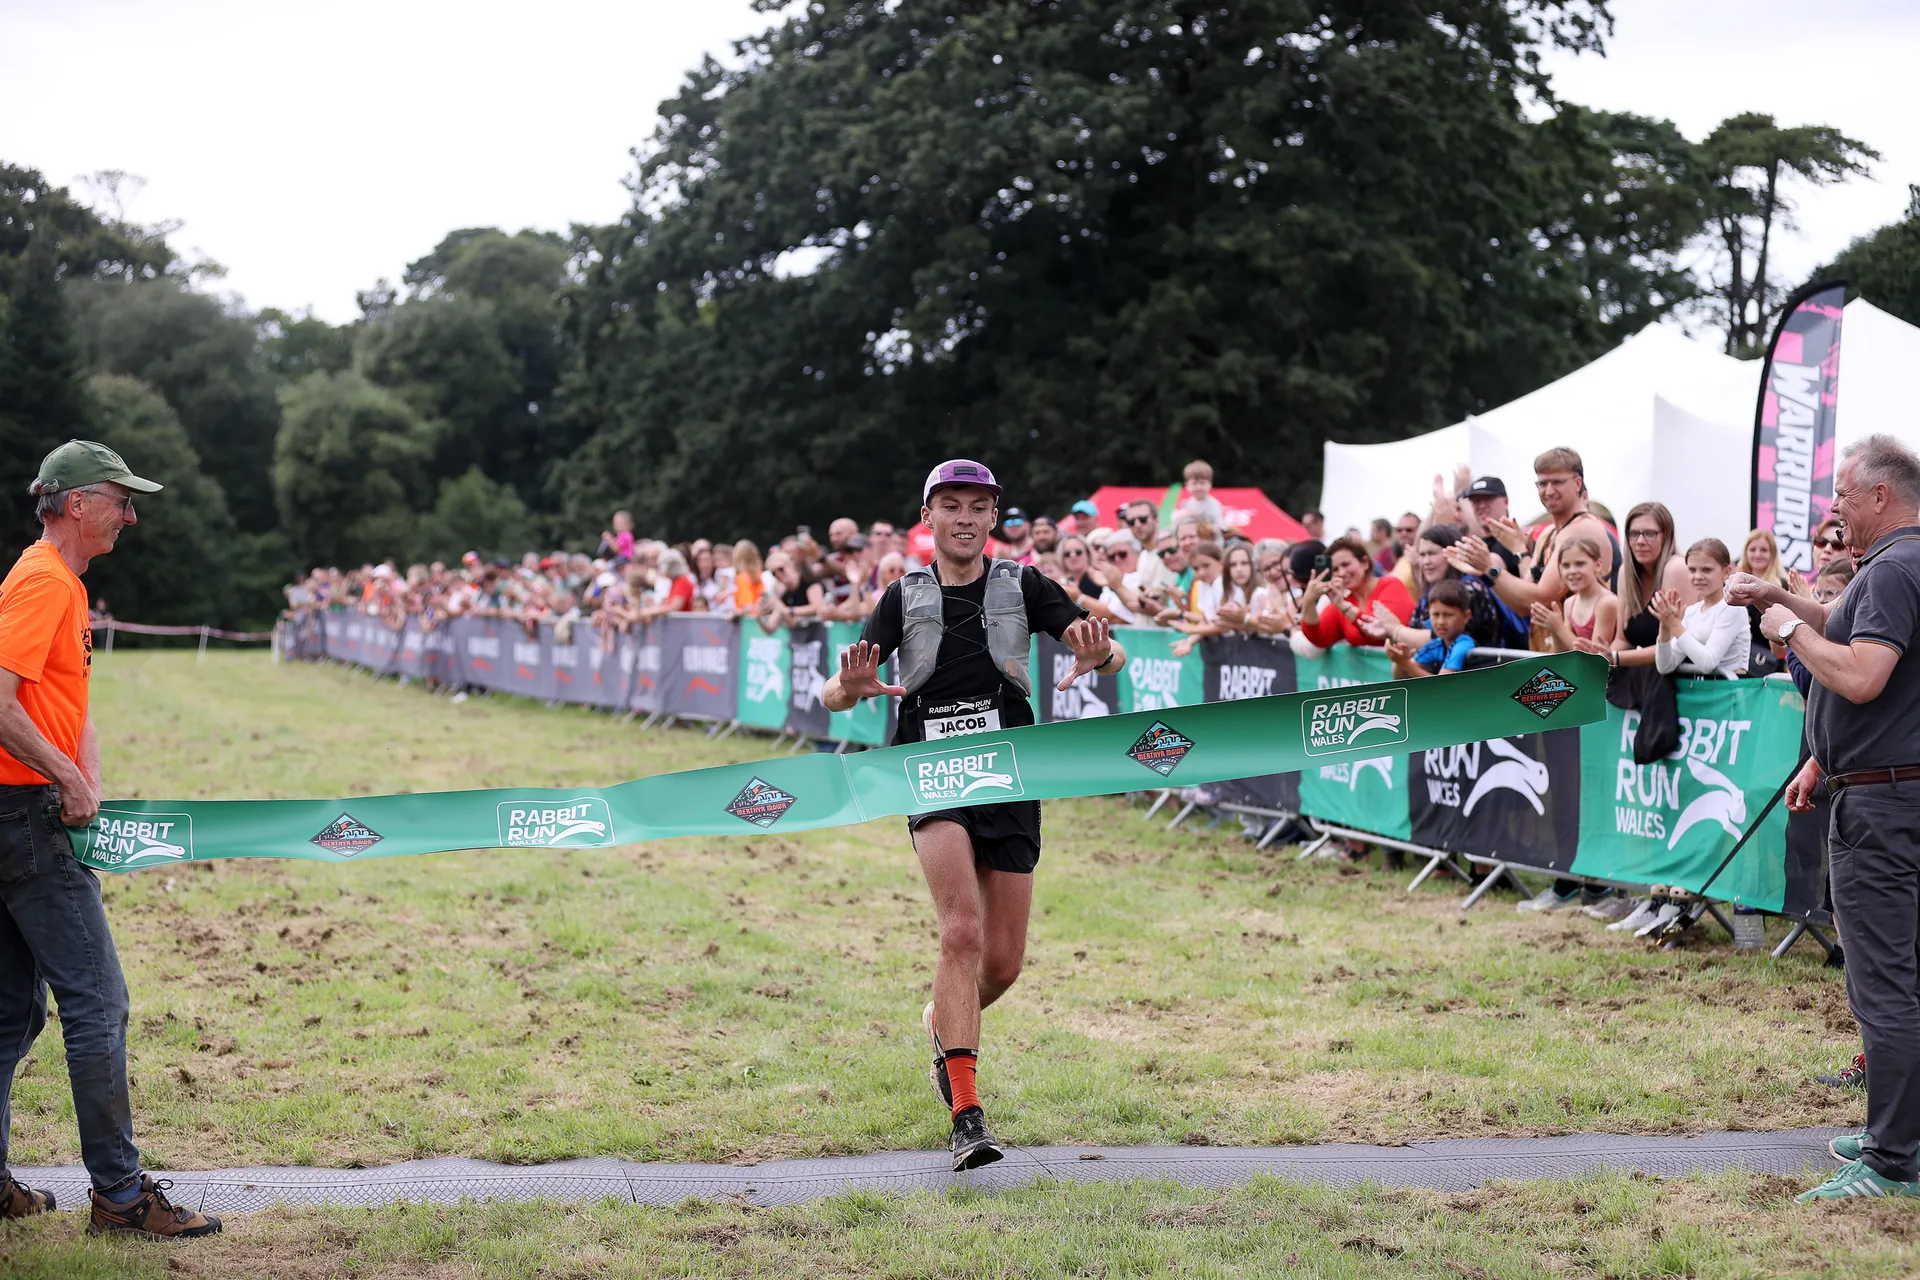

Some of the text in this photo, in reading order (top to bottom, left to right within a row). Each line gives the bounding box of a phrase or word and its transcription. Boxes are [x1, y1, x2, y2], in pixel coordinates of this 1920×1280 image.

[1772, 363, 1820, 572] WARRIORS
[1219, 665, 1277, 699] RABBIT
[929, 699, 991, 714] RABBIT RUN
[1312, 696, 1391, 719] RABBIT
[1521, 694, 1548, 703] MERTHYR
[940, 717, 987, 733] JACOB
[1310, 716, 1355, 736] RUN
[1311, 734, 1345, 748] WALES
[1620, 709, 1752, 765] RBBIT
[1137, 747, 1185, 760] MERTHYR MAWR
[1424, 741, 1480, 779] RUN
[918, 752, 997, 779] RABBIT
[919, 773, 965, 792] RUN
[1615, 758, 1682, 810] RUN
[921, 789, 957, 800] WALES
[1426, 778, 1461, 808] WALES
[510, 804, 592, 827] RABBIT
[736, 803, 787, 815] MERTHYR MAWR
[98, 818, 174, 839] RABBIT
[1615, 806, 1666, 839] WALES
[507, 825, 556, 842] RUN
[508, 838, 545, 847] WALES
[94, 833, 136, 855] RUN
[92, 849, 123, 865] WALES
